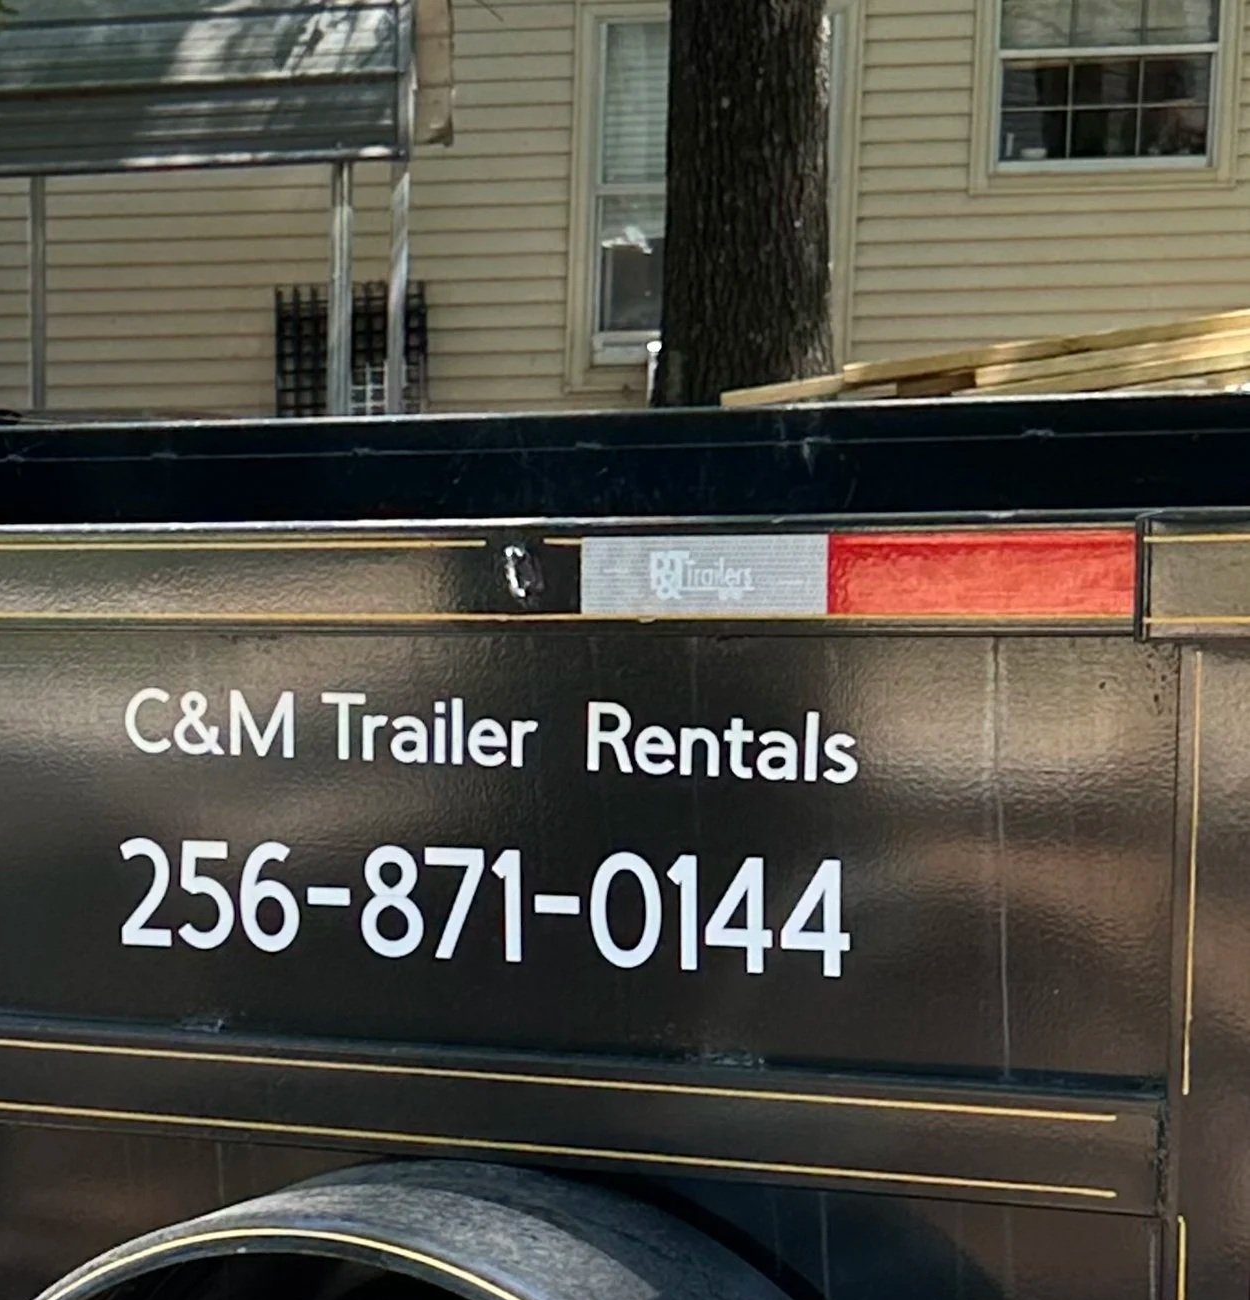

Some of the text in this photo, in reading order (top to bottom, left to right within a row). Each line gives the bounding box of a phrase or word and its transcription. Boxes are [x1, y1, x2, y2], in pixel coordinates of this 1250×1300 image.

[124, 686, 860, 785] C&M Trailer Rentals
[119, 836, 852, 978] 256-871-0144
